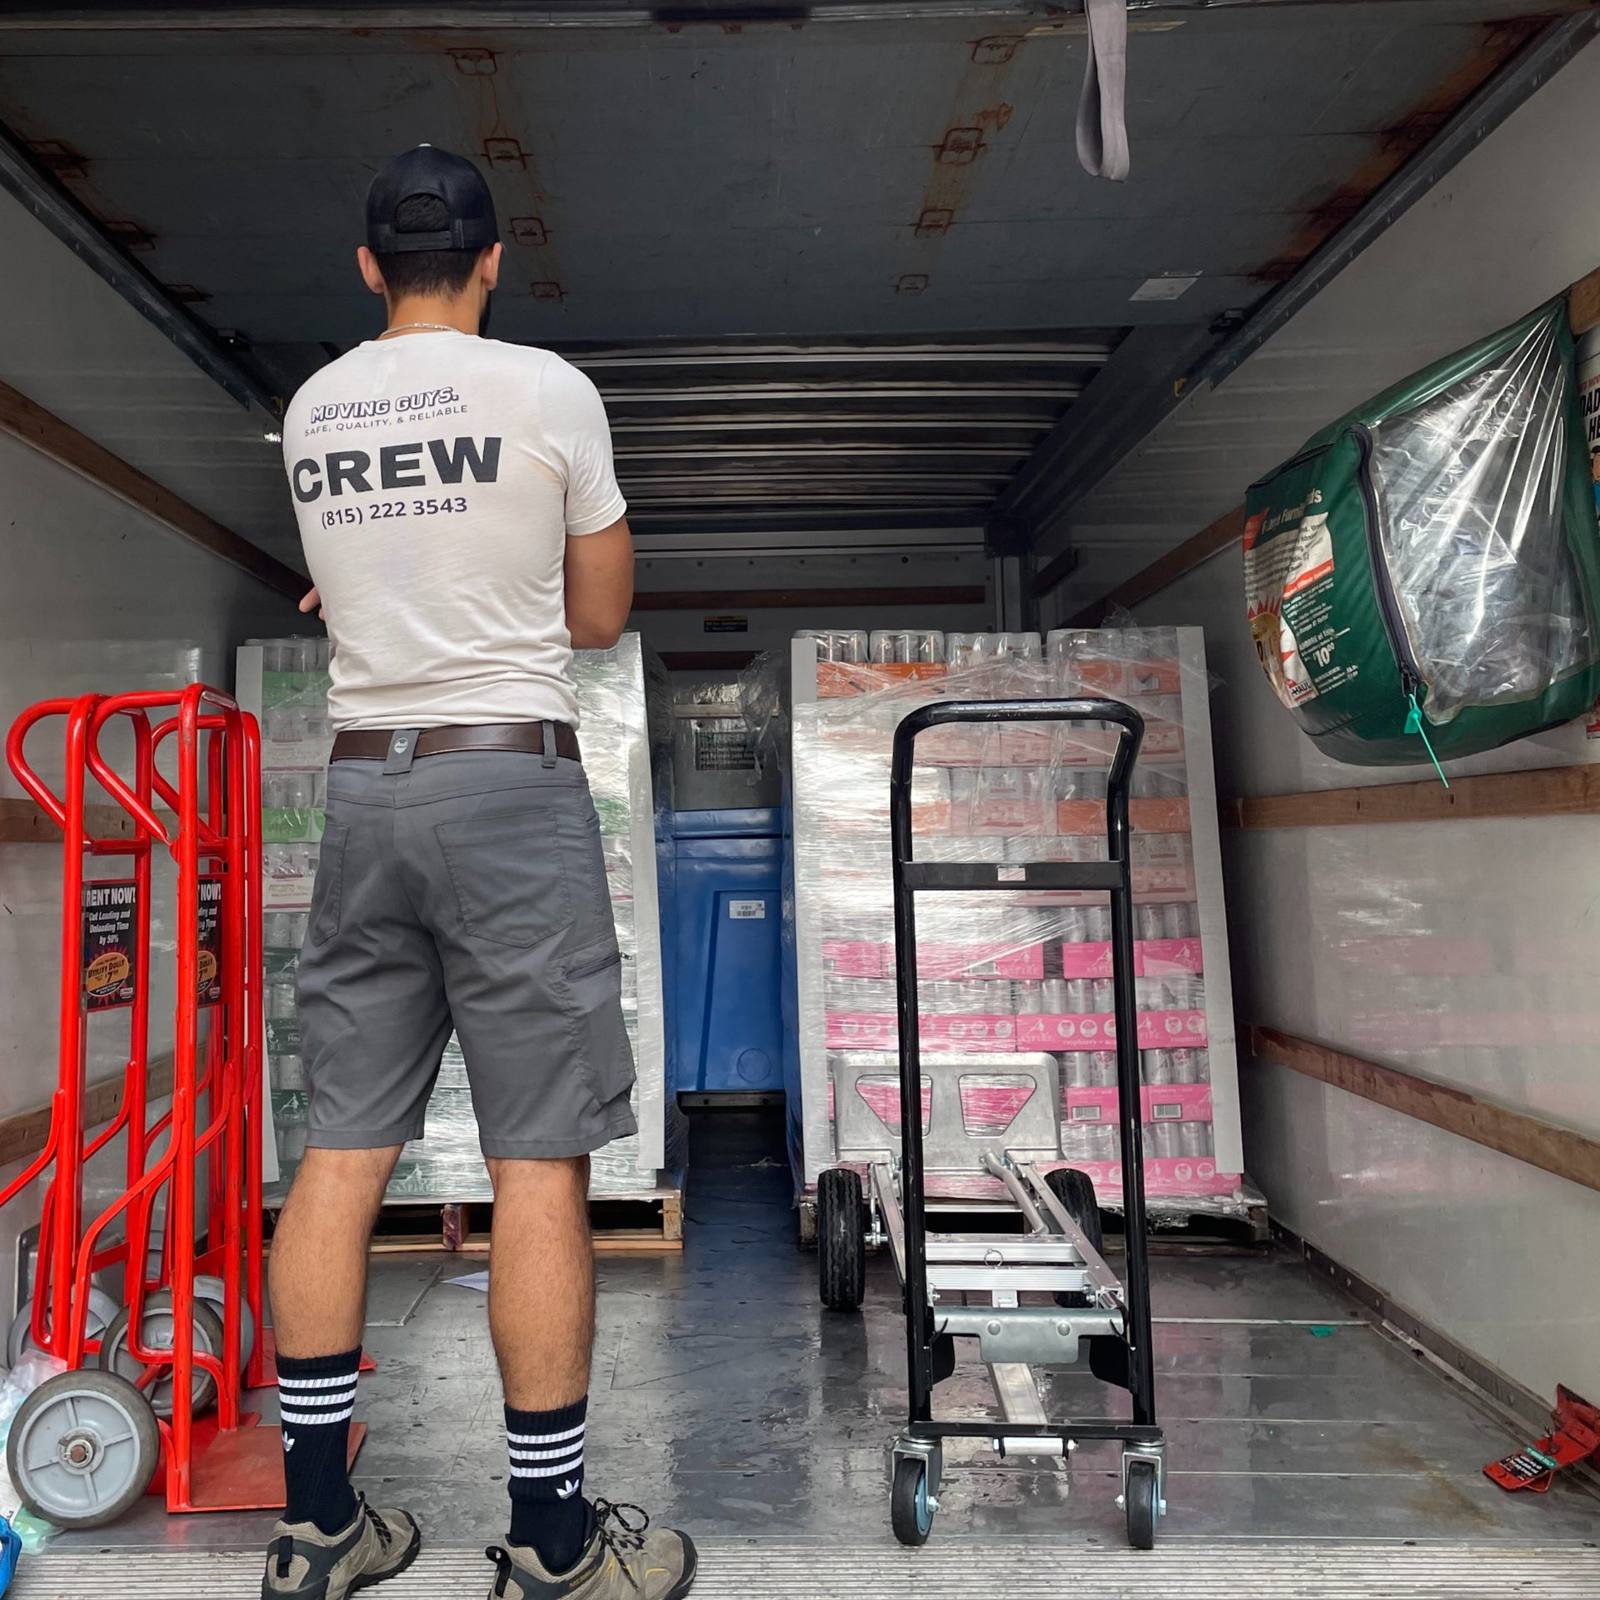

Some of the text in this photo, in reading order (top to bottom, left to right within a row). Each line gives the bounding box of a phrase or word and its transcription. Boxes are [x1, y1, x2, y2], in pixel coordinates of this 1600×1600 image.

[305, 405, 467, 437] SAFE, QUALITY, & RELIABLE
[311, 386, 459, 424] MOVING GUYS.
[293, 437, 502, 503] CREW
[321, 497, 468, 530] (815) 222 3543
[86, 886, 136, 907] RENT NOW!
